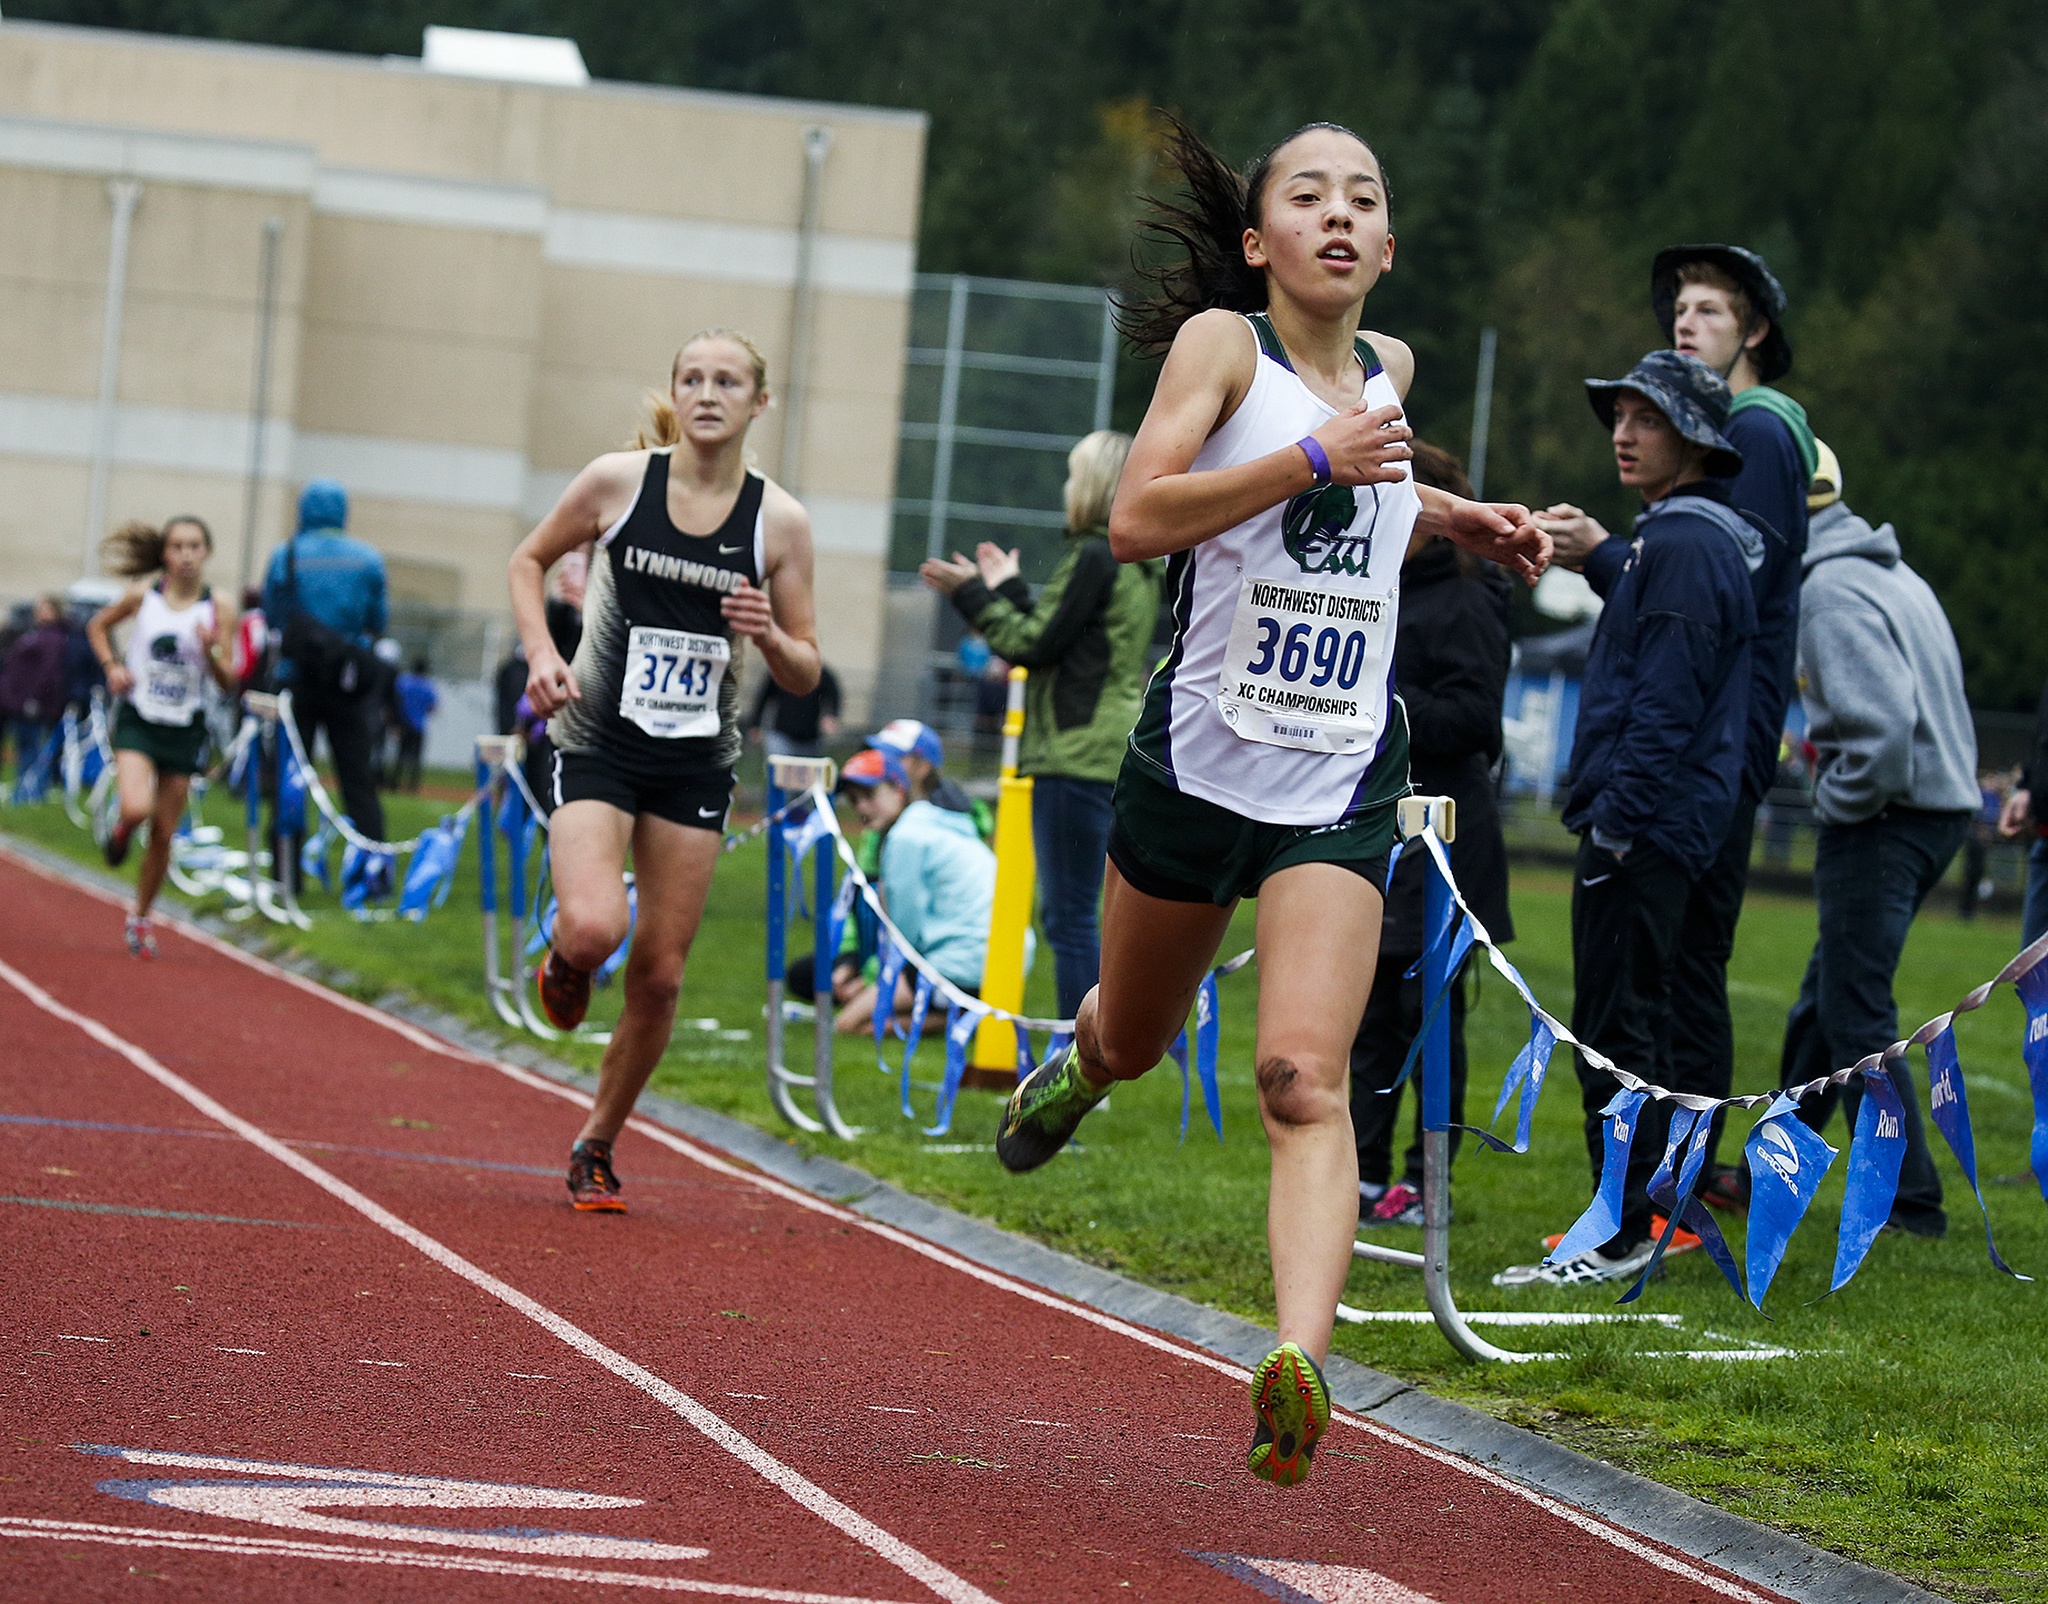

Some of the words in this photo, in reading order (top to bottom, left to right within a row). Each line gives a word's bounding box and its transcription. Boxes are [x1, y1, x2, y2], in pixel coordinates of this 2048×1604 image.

[1250, 583, 1326, 616] NORTHWEST
[1326, 595, 1381, 623] DISTRICTS
[640, 652, 712, 696] 3743
[1246, 617, 1366, 690] 3690
[1237, 682, 1255, 700] XC
[1258, 687, 1358, 717] CHAMPIONSHIPS
[1875, 1109, 1899, 1139] Run
[1756, 1145, 1799, 1197] BROOKS
